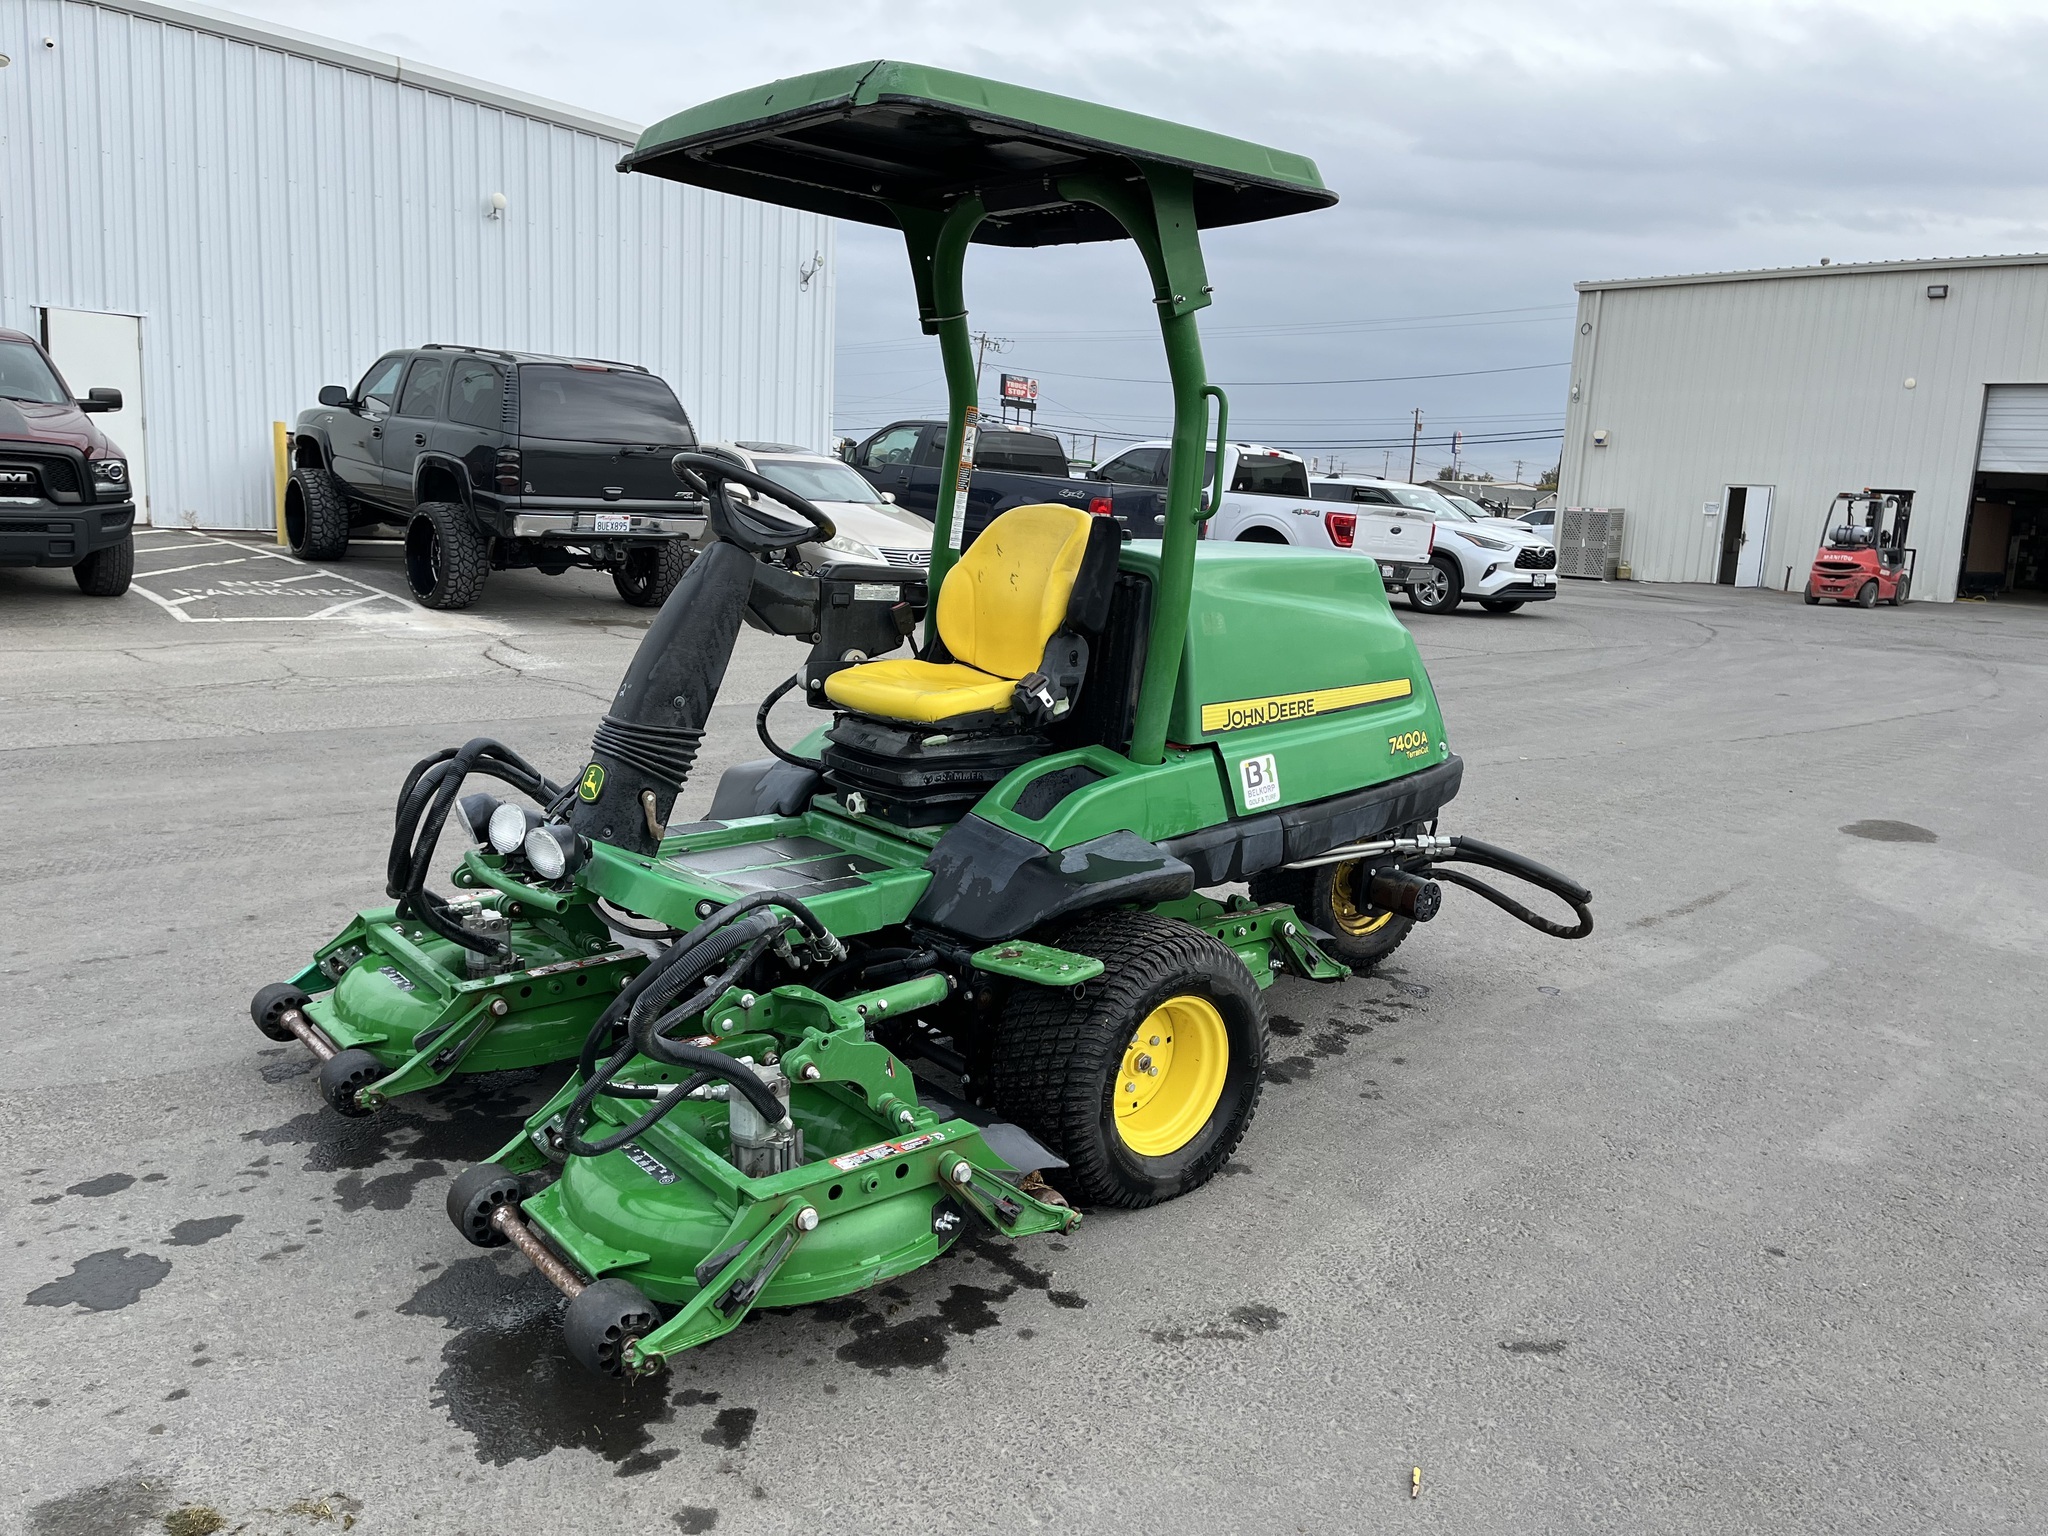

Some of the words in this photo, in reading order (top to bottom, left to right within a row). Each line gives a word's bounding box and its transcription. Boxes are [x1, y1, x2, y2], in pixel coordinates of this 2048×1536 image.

[1006, 381, 1028, 390] TRUCK
[1008, 387, 1026, 396] STOP
[597, 521, 628, 531] 8UEX895
[1823, 554, 1854, 562] MANITOU
[172, 588, 363, 596] PARKING
[1222, 706, 1265, 728] JOHN
[1268, 698, 1315, 719] DEERE
[1388, 730, 1428, 755] 7400A
[933, 771, 983, 783] GRAMMER
[1247, 783, 1276, 798] BELKORP
[1249, 797, 1261, 806] GOLF
[1264, 792, 1277, 801] TURF
